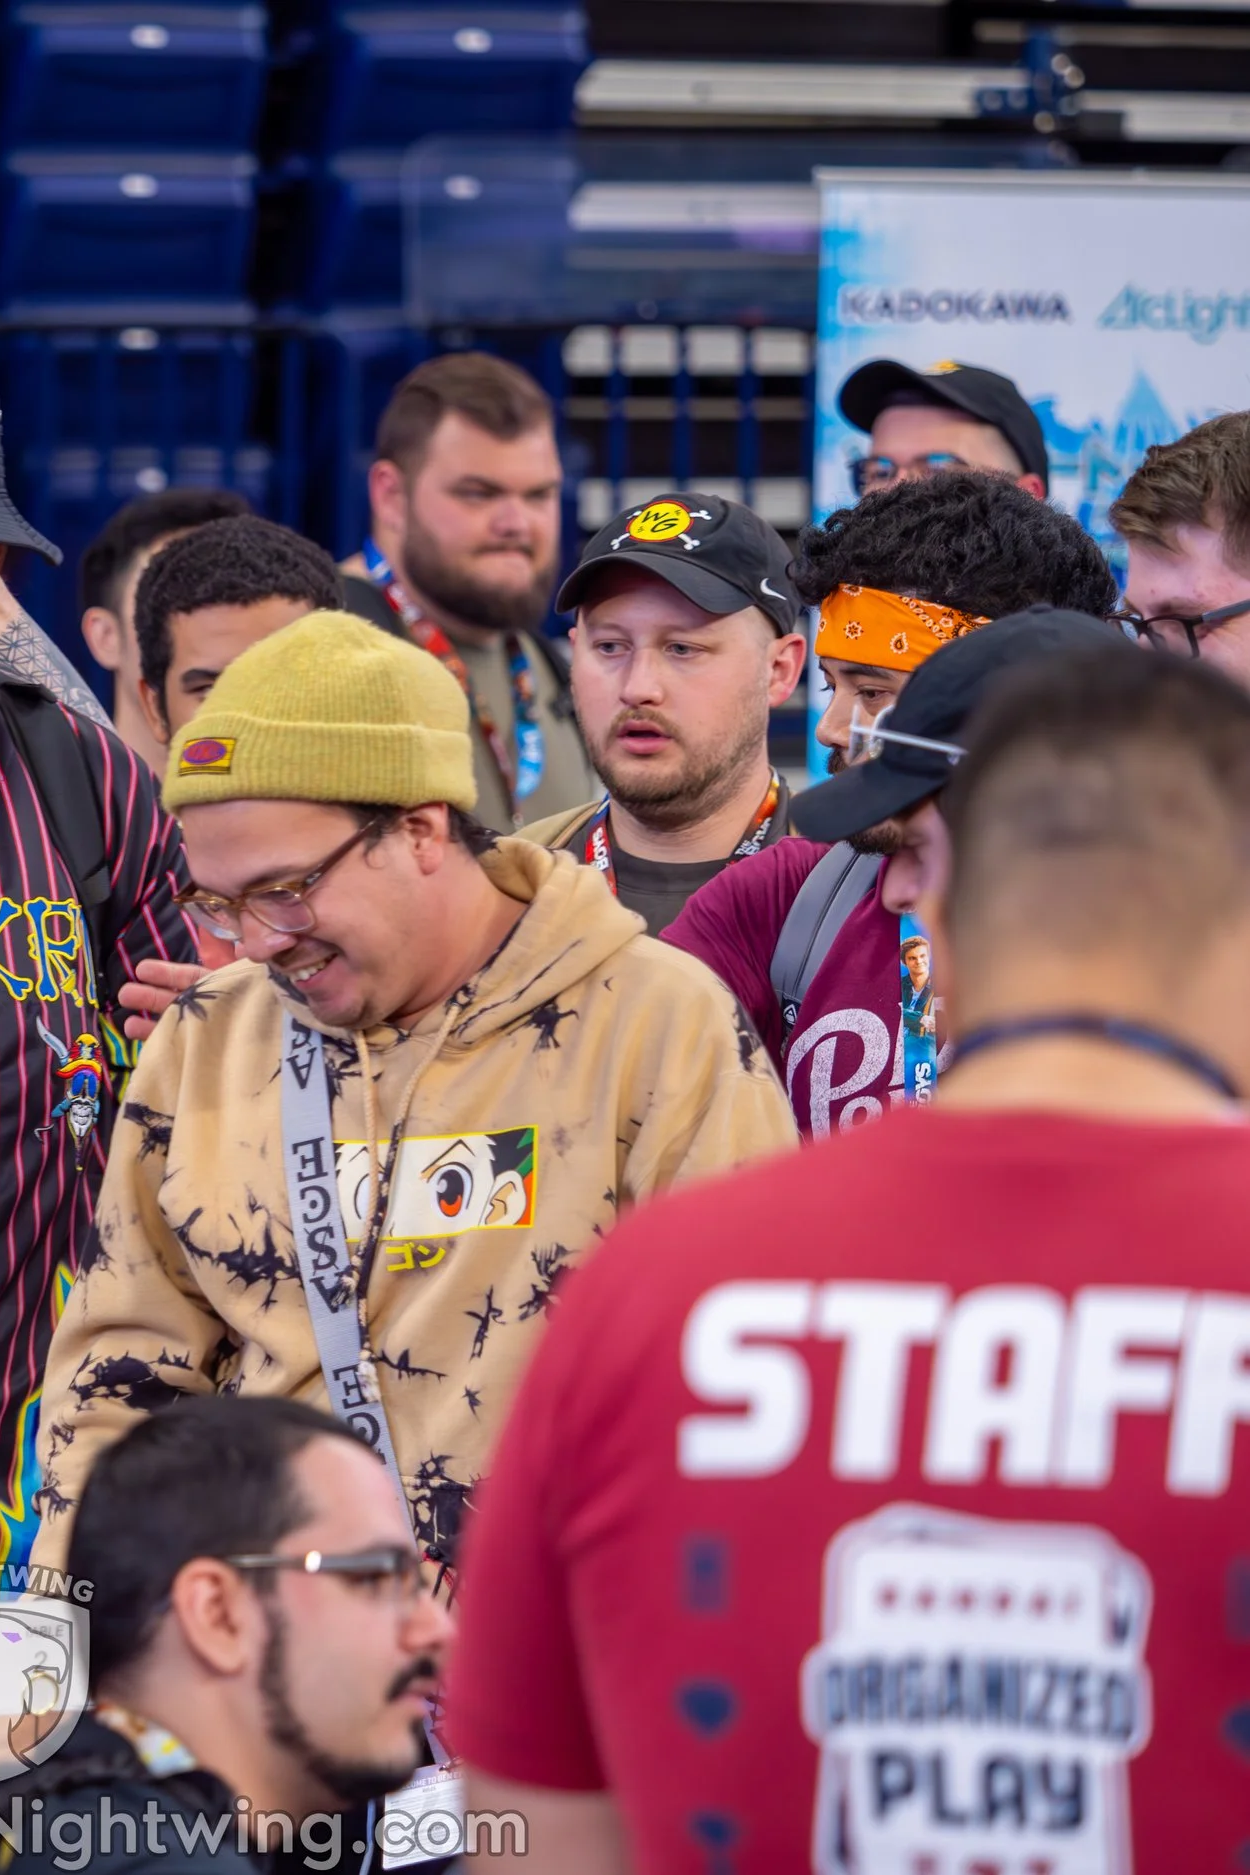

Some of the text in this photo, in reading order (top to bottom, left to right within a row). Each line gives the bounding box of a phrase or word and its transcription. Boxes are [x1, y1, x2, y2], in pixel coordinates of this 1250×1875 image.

[842, 287, 1072, 323] KADOKAWA
[915, 1062, 931, 1108] OYS
[386, 1241, 446, 1272] ゴン
[824, 1651, 1134, 1742] ORGANIZED
[870, 1748, 1085, 1830] PLAY
